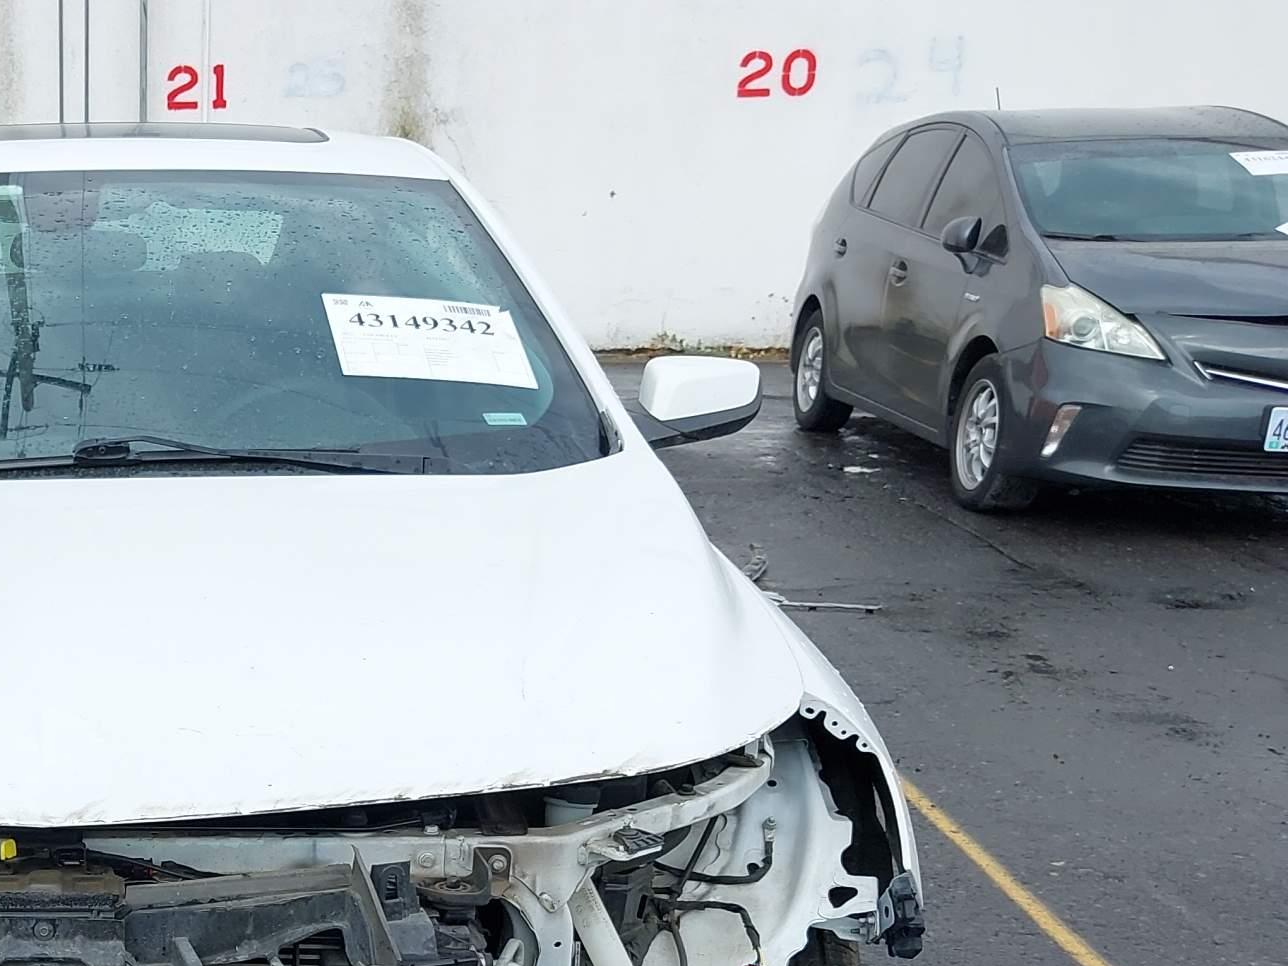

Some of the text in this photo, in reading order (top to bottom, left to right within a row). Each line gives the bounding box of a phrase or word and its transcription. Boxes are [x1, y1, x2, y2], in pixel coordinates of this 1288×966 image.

[167, 64, 228, 110] 21
[737, 48, 817, 97] 20
[348, 311, 496, 336] 43149342
